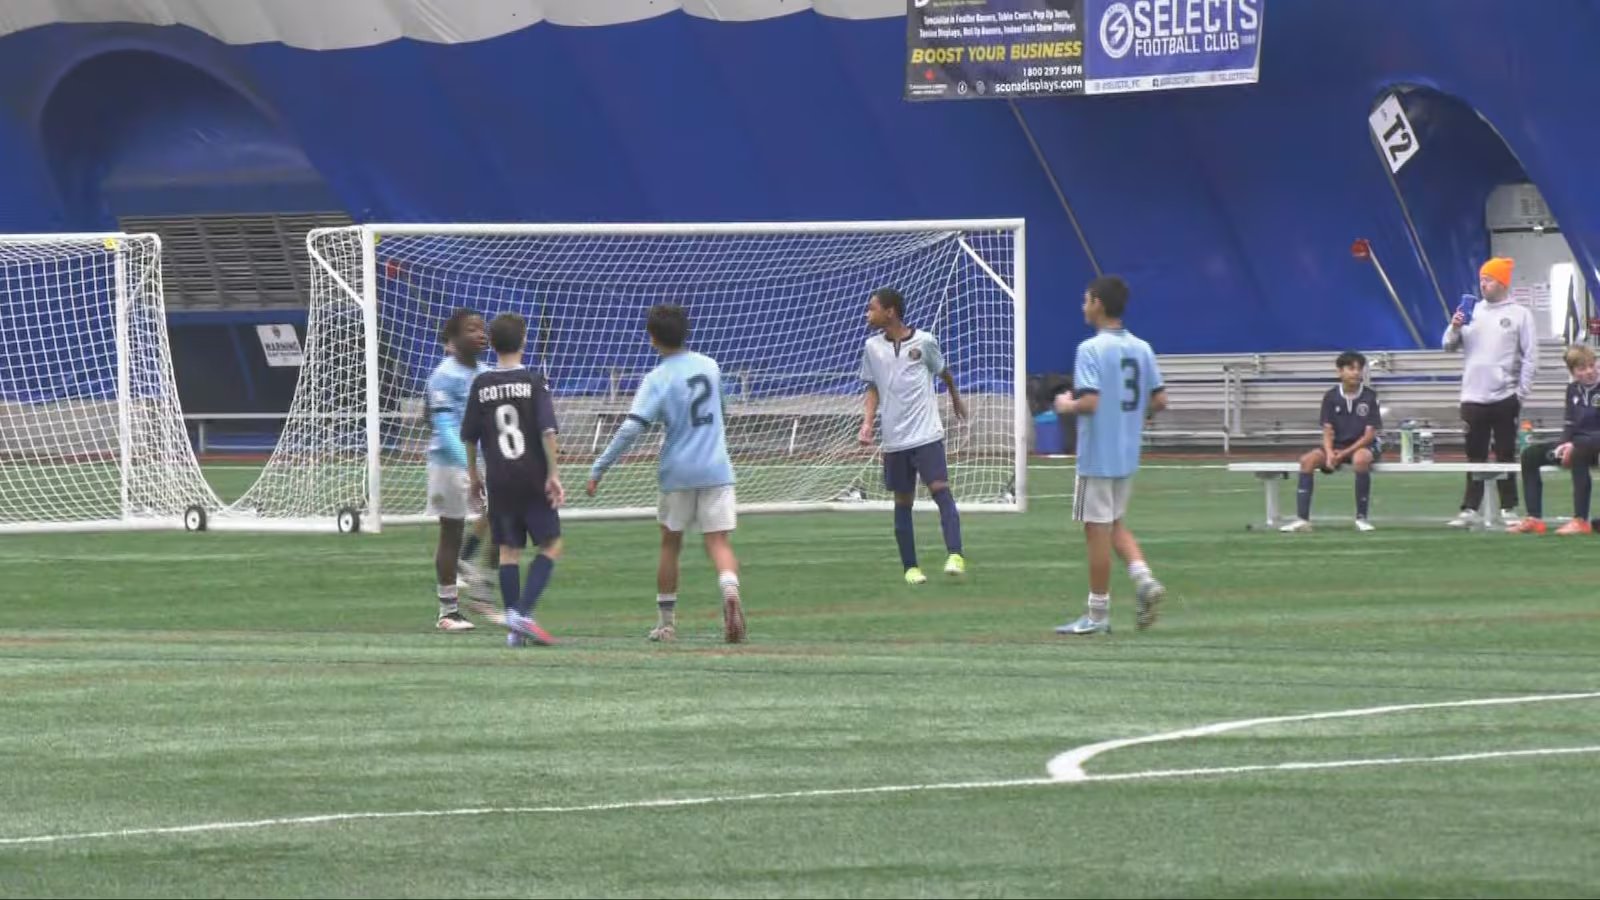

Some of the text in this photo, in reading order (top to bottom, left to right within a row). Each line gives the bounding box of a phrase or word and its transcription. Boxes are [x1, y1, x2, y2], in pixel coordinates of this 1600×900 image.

[1134, 0, 1258, 38] SELECTS
[911, 40, 1082, 64] BOOST YOUR BUSINESS
[1135, 35, 1200, 57] FOOTBALL
[1204, 32, 1239, 51] CLUB
[994, 79, 1083, 93] sconadisplays.com
[1044, 66, 1060, 76] 297
[1383, 112, 1412, 162] T2
[478, 383, 532, 403] SCOTTISH
[1119, 357, 1141, 412] 3
[686, 373, 714, 428] 2
[496, 403, 526, 460] 8
